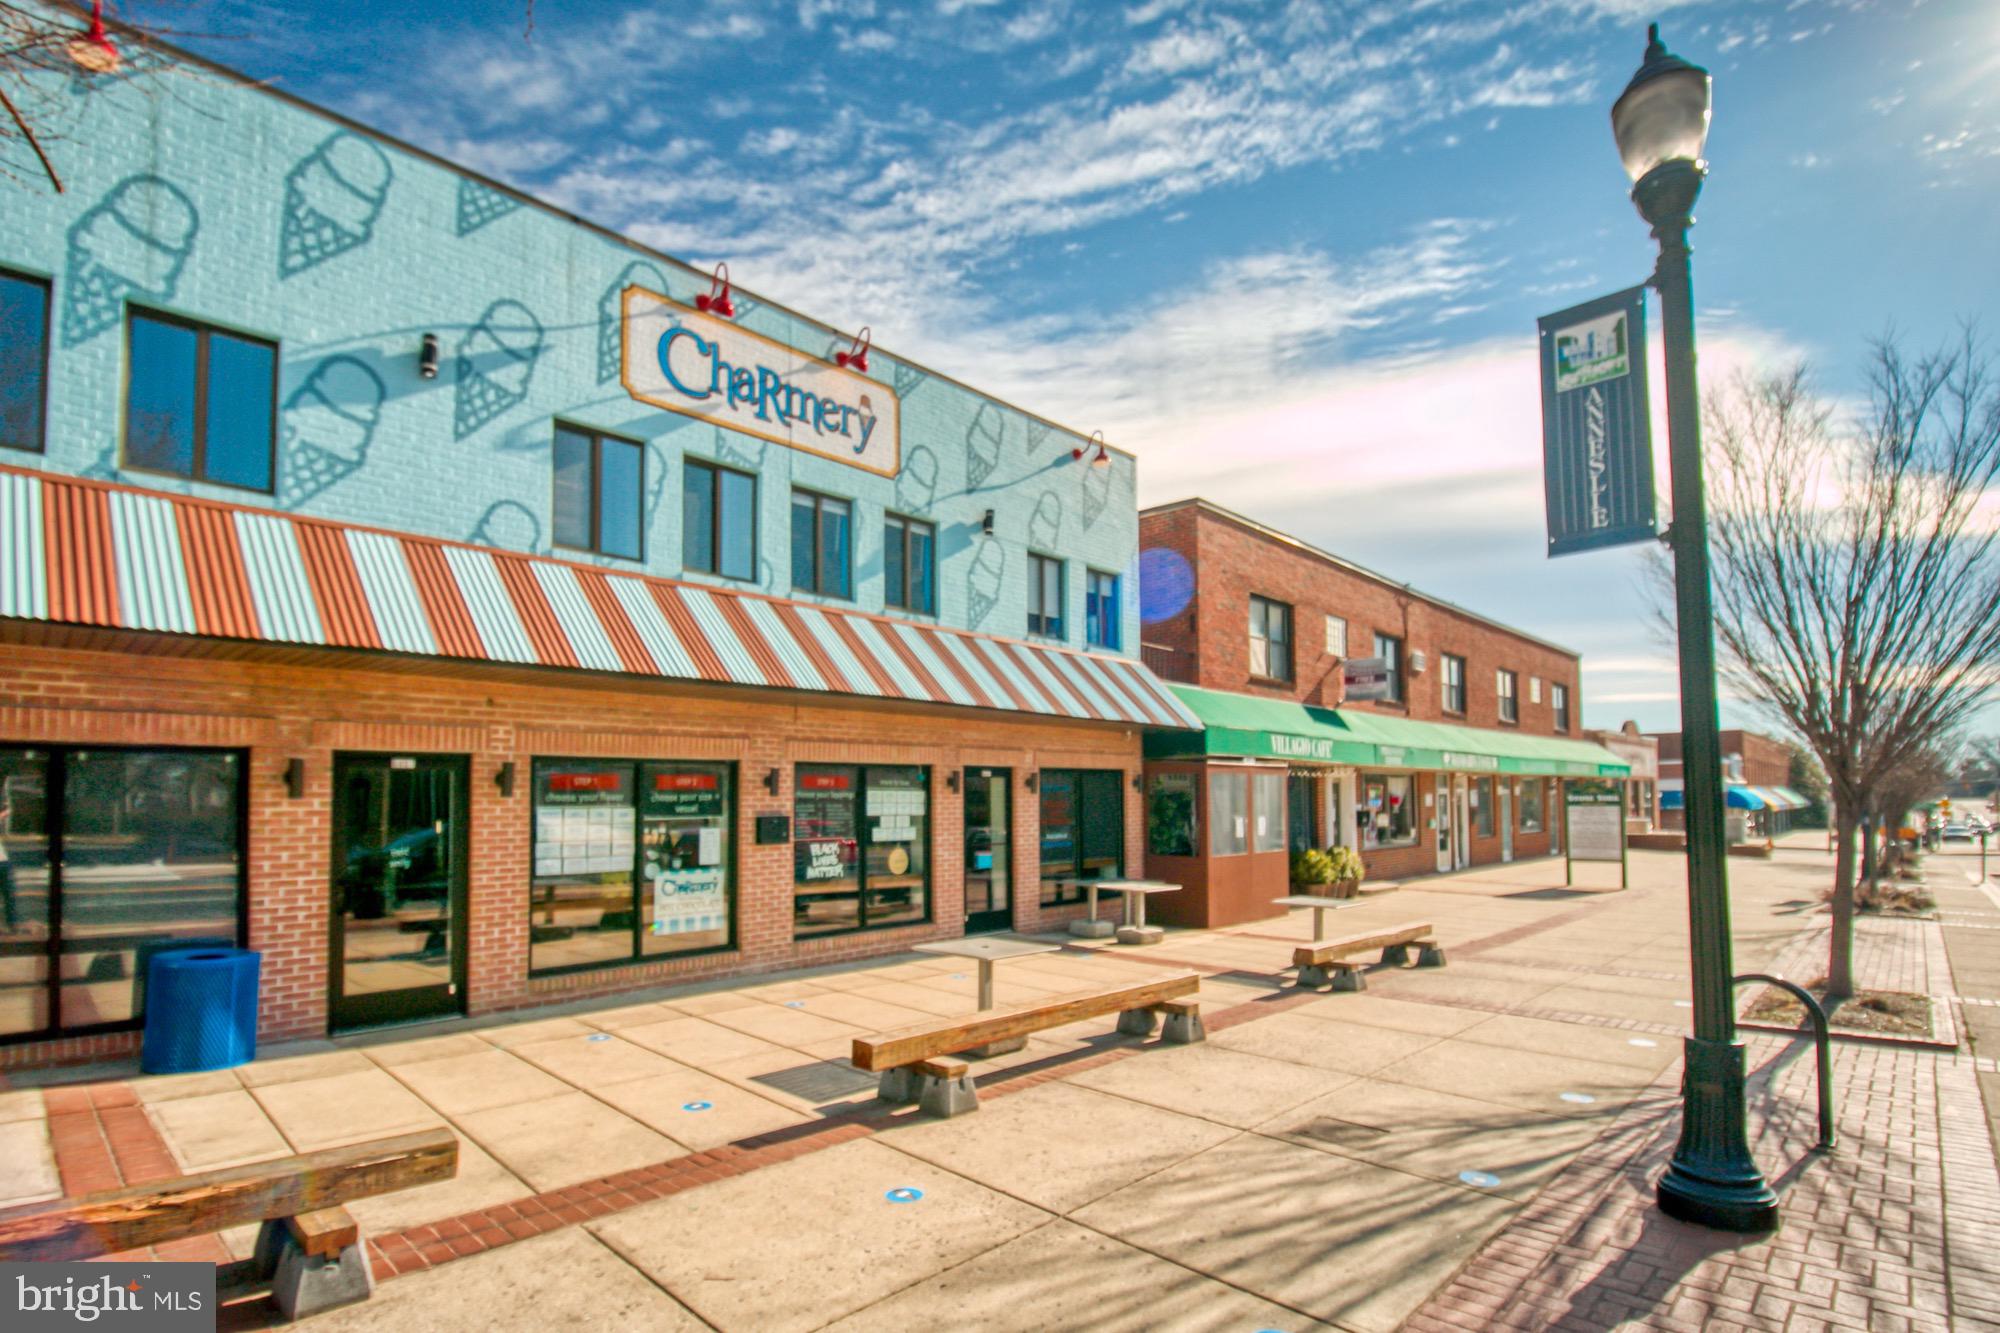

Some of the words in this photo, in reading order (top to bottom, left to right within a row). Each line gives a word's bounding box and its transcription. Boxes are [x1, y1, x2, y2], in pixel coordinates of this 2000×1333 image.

[1584, 386, 1610, 529] ANNESLIE
[573, 777, 592, 786] STEP
[809, 841, 841, 857] BLACK
[811, 855, 839, 867] LIVES
[806, 863, 844, 880] MATTER
